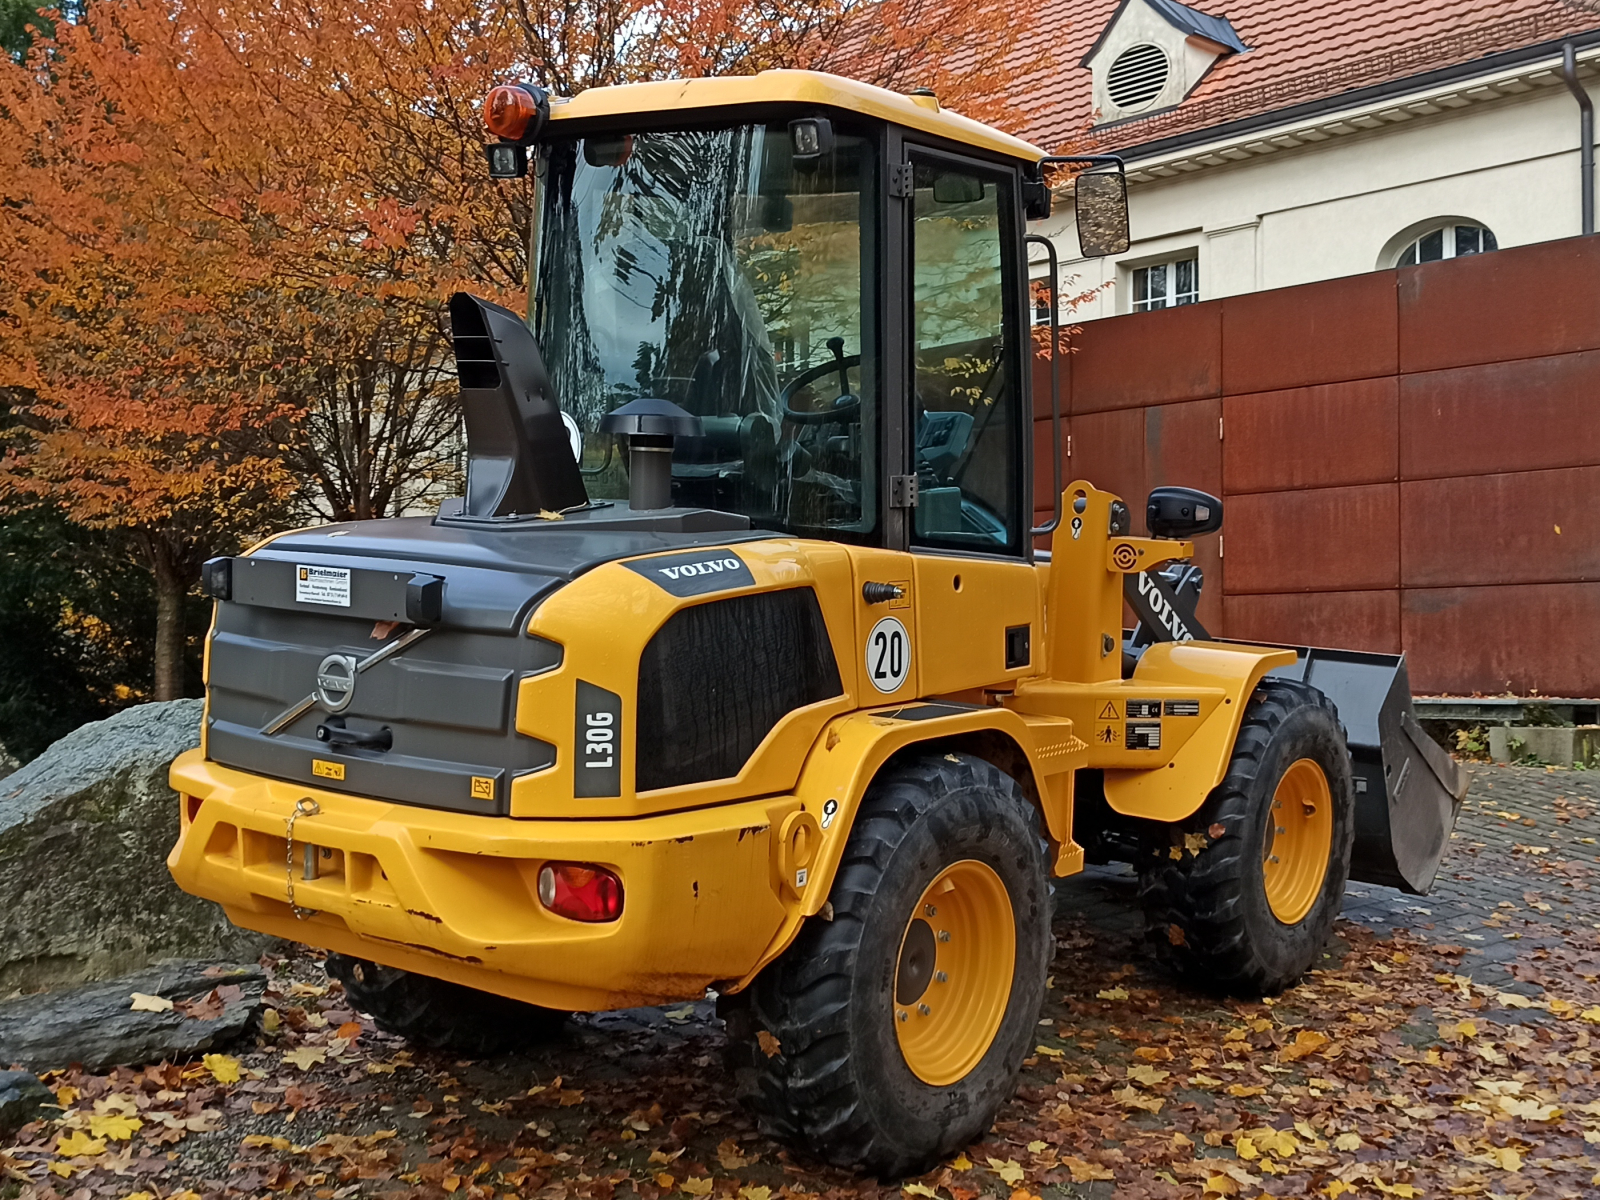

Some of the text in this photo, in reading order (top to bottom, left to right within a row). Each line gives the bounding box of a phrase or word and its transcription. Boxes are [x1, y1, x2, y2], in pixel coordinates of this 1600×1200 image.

[308, 568, 348, 578] Brielmaier
[658, 558, 740, 580] VOLVO
[874, 631, 902, 679] 20
[585, 712, 614, 768] L30G
